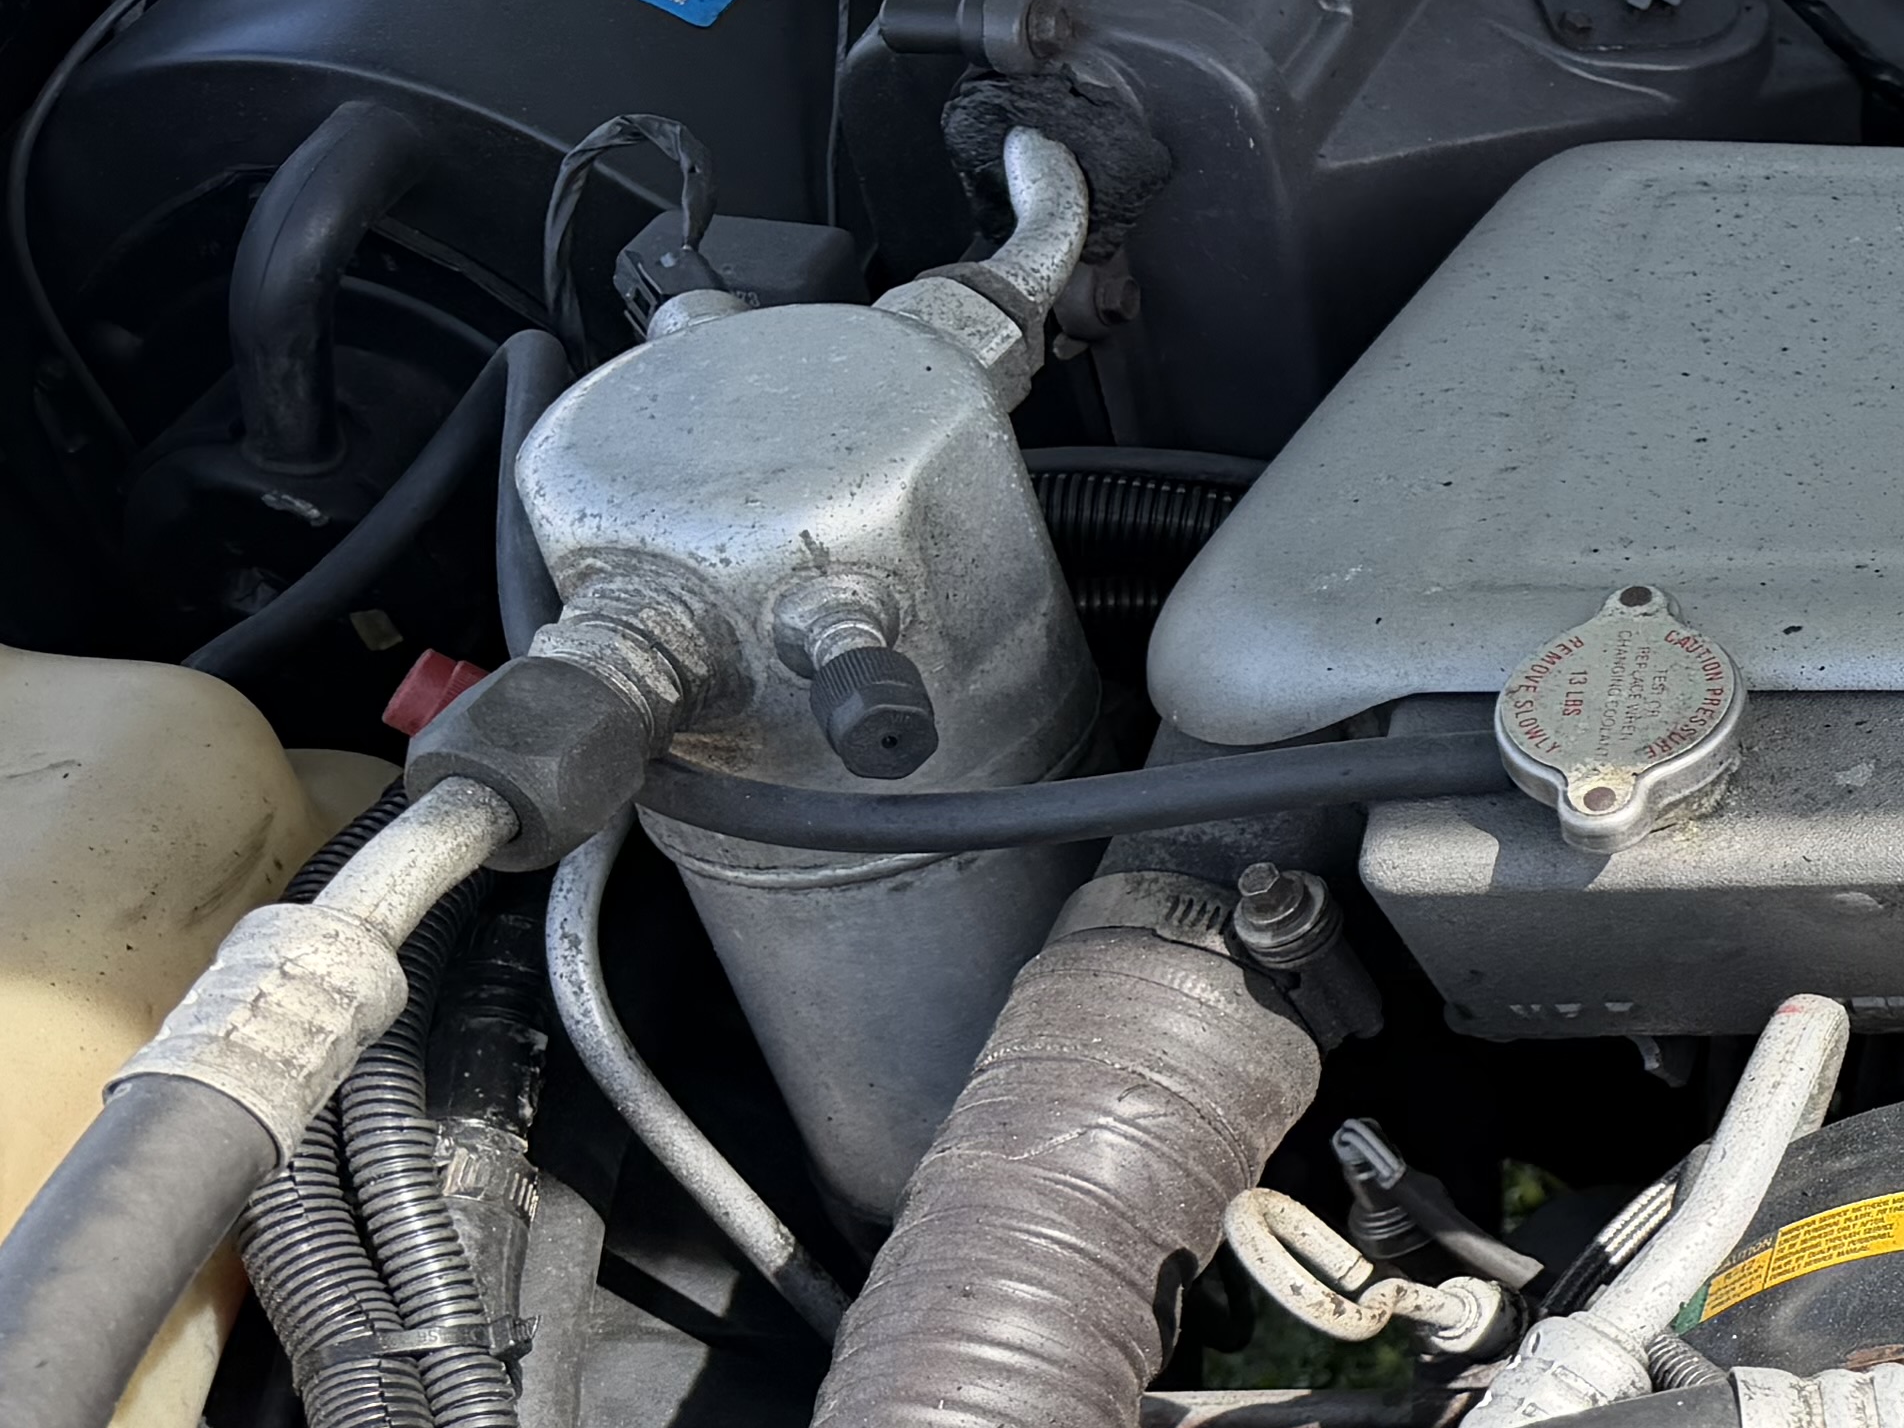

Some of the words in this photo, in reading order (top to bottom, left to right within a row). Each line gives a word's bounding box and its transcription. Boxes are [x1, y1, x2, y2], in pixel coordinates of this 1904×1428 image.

[1518, 636, 1584, 693] REMOVE
[1568, 670, 1587, 685] 13
[1607, 630, 1632, 697] CHANGING
[1627, 647, 1649, 699] REPLACE
[1663, 630, 1723, 681] CAUTION
[1562, 691, 1583, 716] LBS
[1652, 669, 1668, 696] TEST
[1513, 700, 1561, 754] SLOWLY
[1593, 701, 1618, 762] COOLANT
[1618, 703, 1639, 741] WHEN
[1637, 688, 1724, 759] PRESSURE
